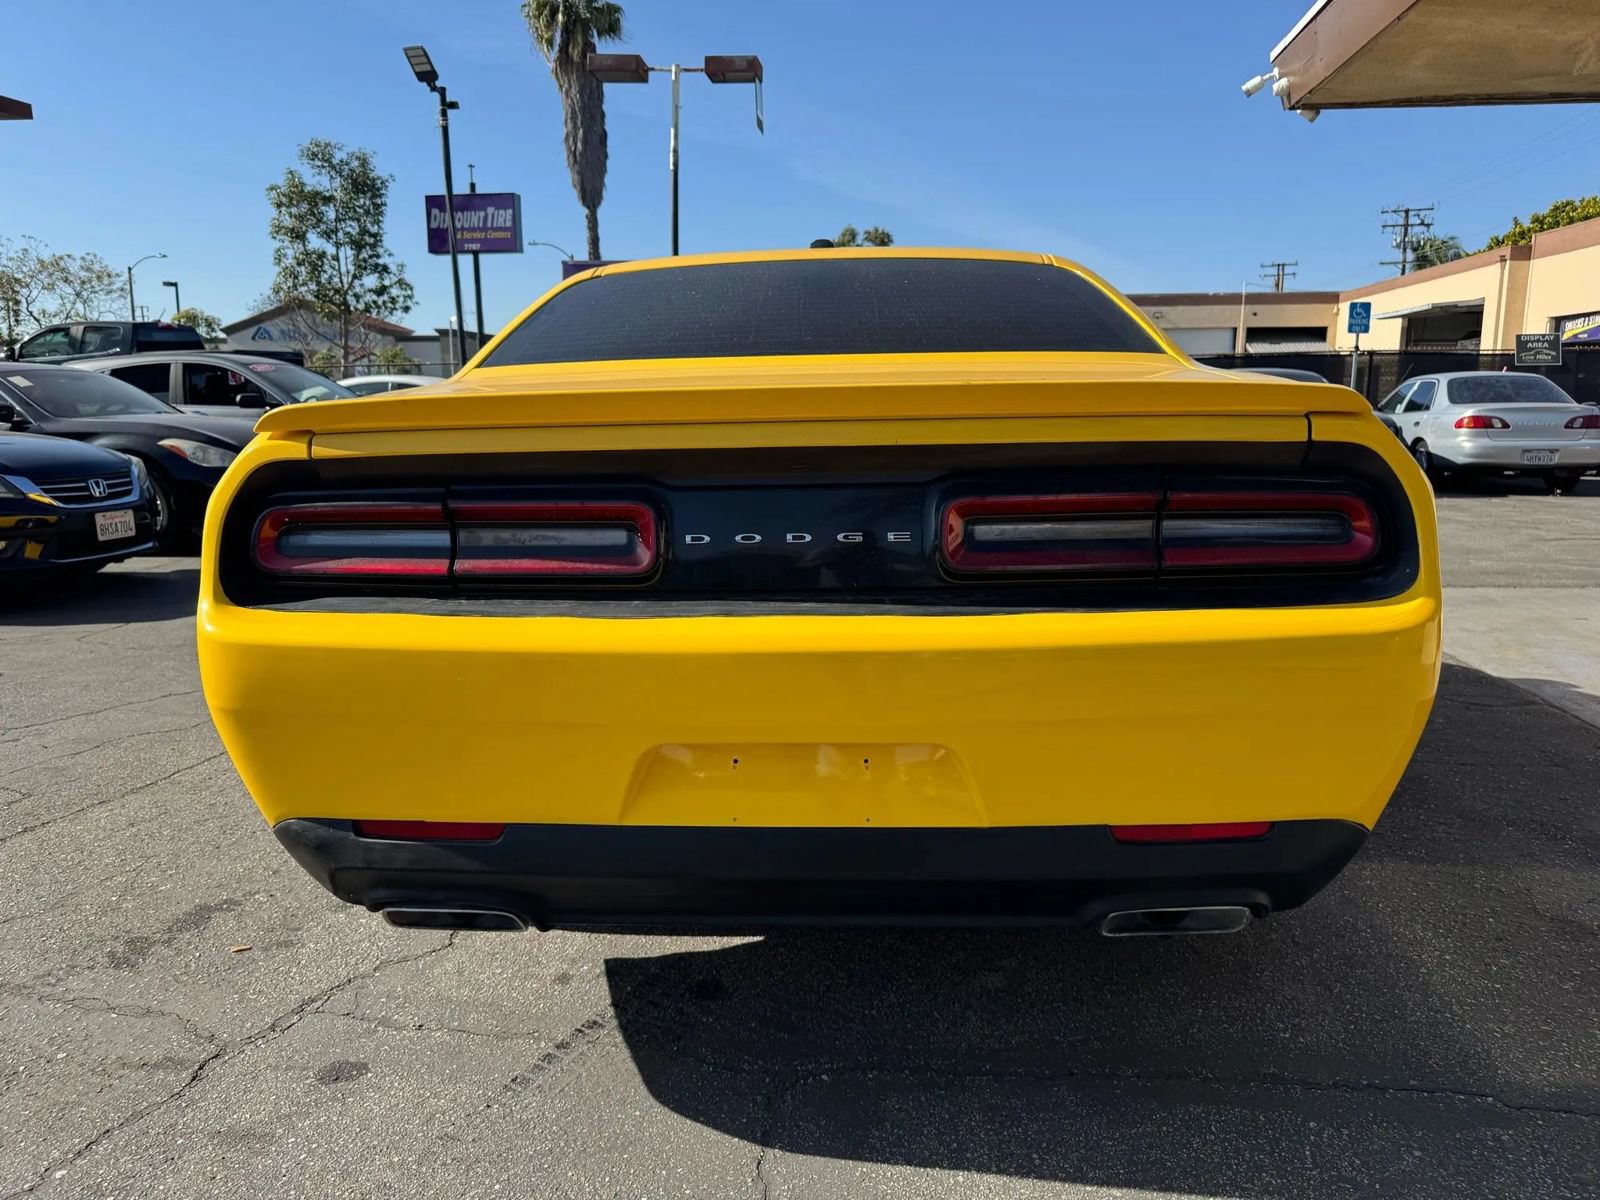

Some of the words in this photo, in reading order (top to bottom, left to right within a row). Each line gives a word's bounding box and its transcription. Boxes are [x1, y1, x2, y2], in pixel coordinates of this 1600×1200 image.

[486, 206, 513, 228] TIRE
[462, 231, 485, 239] Service
[486, 230, 511, 239] Centers
[685, 531, 912, 544] DODGE
